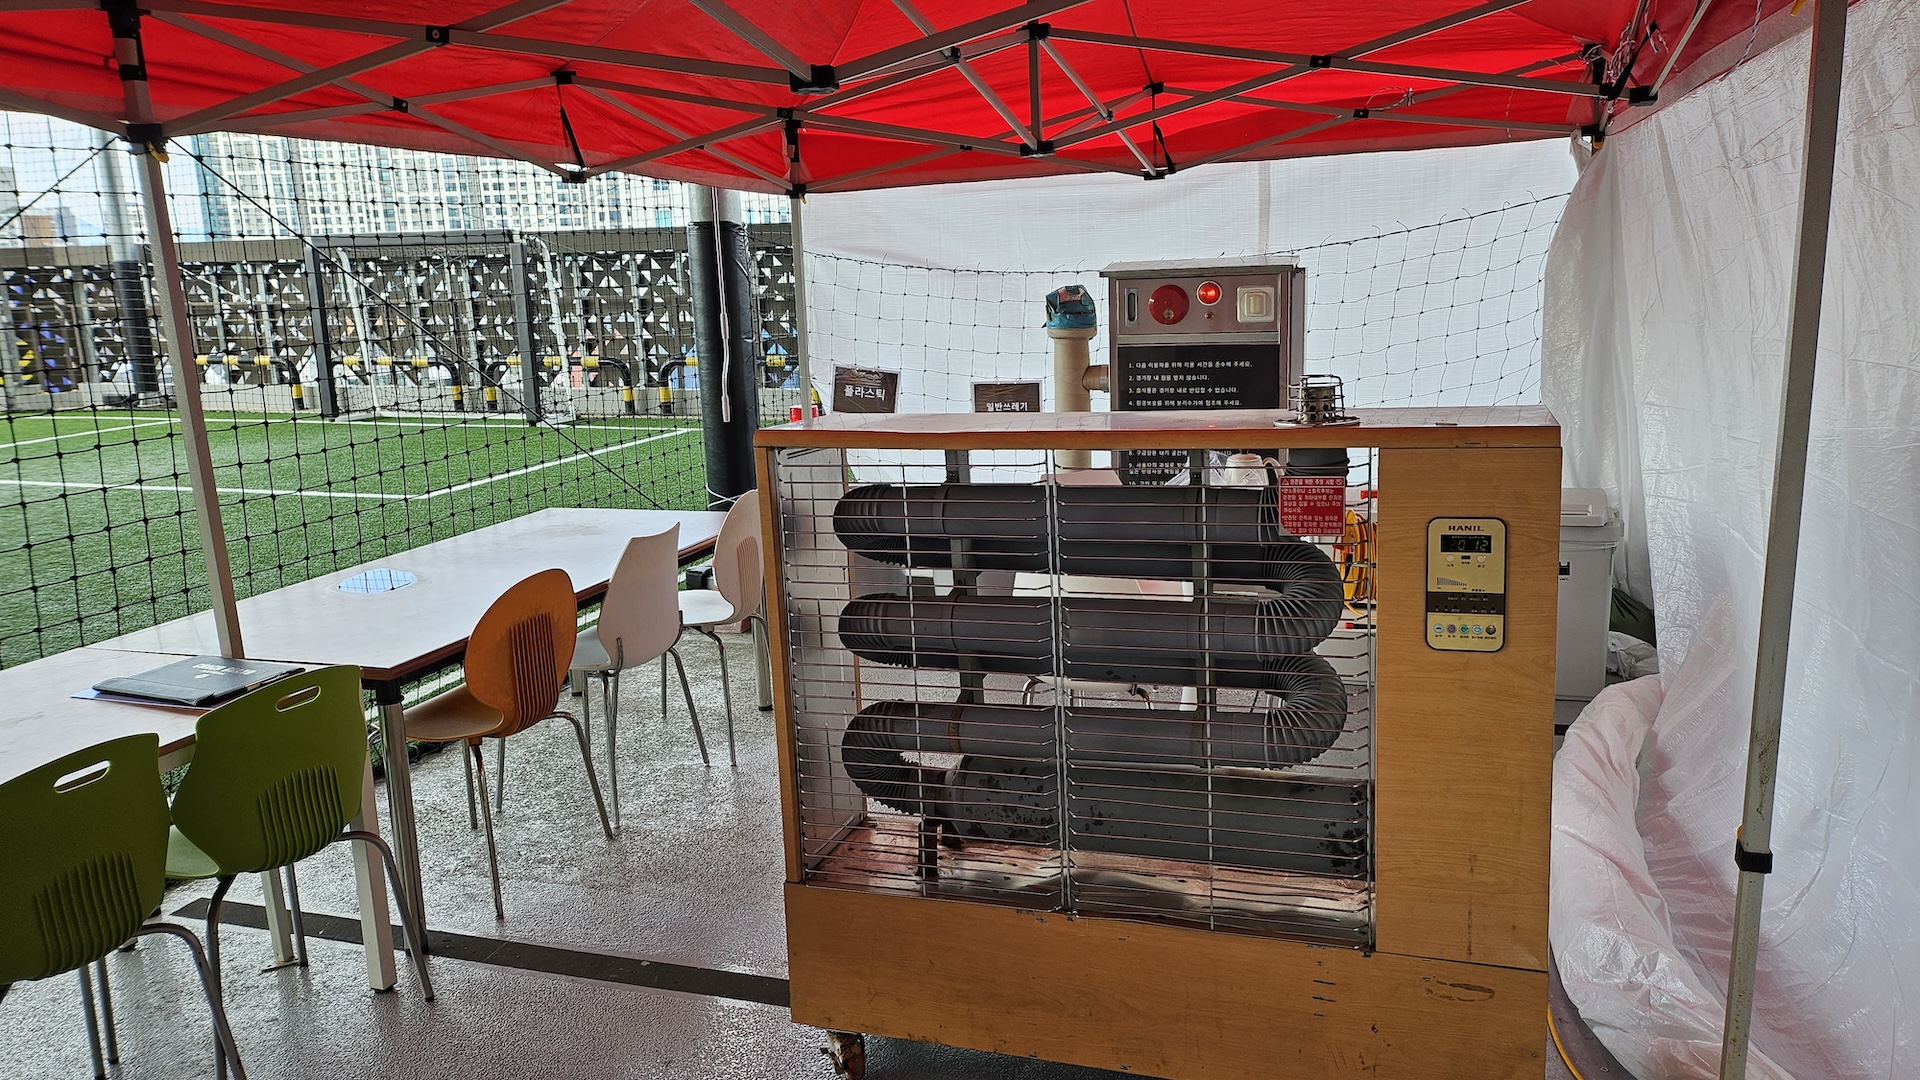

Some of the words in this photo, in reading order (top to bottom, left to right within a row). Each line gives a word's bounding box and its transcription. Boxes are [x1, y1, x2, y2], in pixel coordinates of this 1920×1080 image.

[1136, 361, 1147, 369] 다음
[1148, 361, 1170, 369] 이용자를
[1171, 361, 1182, 369] 위해
[1184, 361, 1195, 369] 이용
[1196, 361, 1214, 369] 시간을
[1215, 361, 1232, 369] 준수해
[1233, 360, 1253, 368] 주세요.
[844, 384, 886, 401] 플라스틱
[986, 401, 1028, 412] 일반쓰레기
